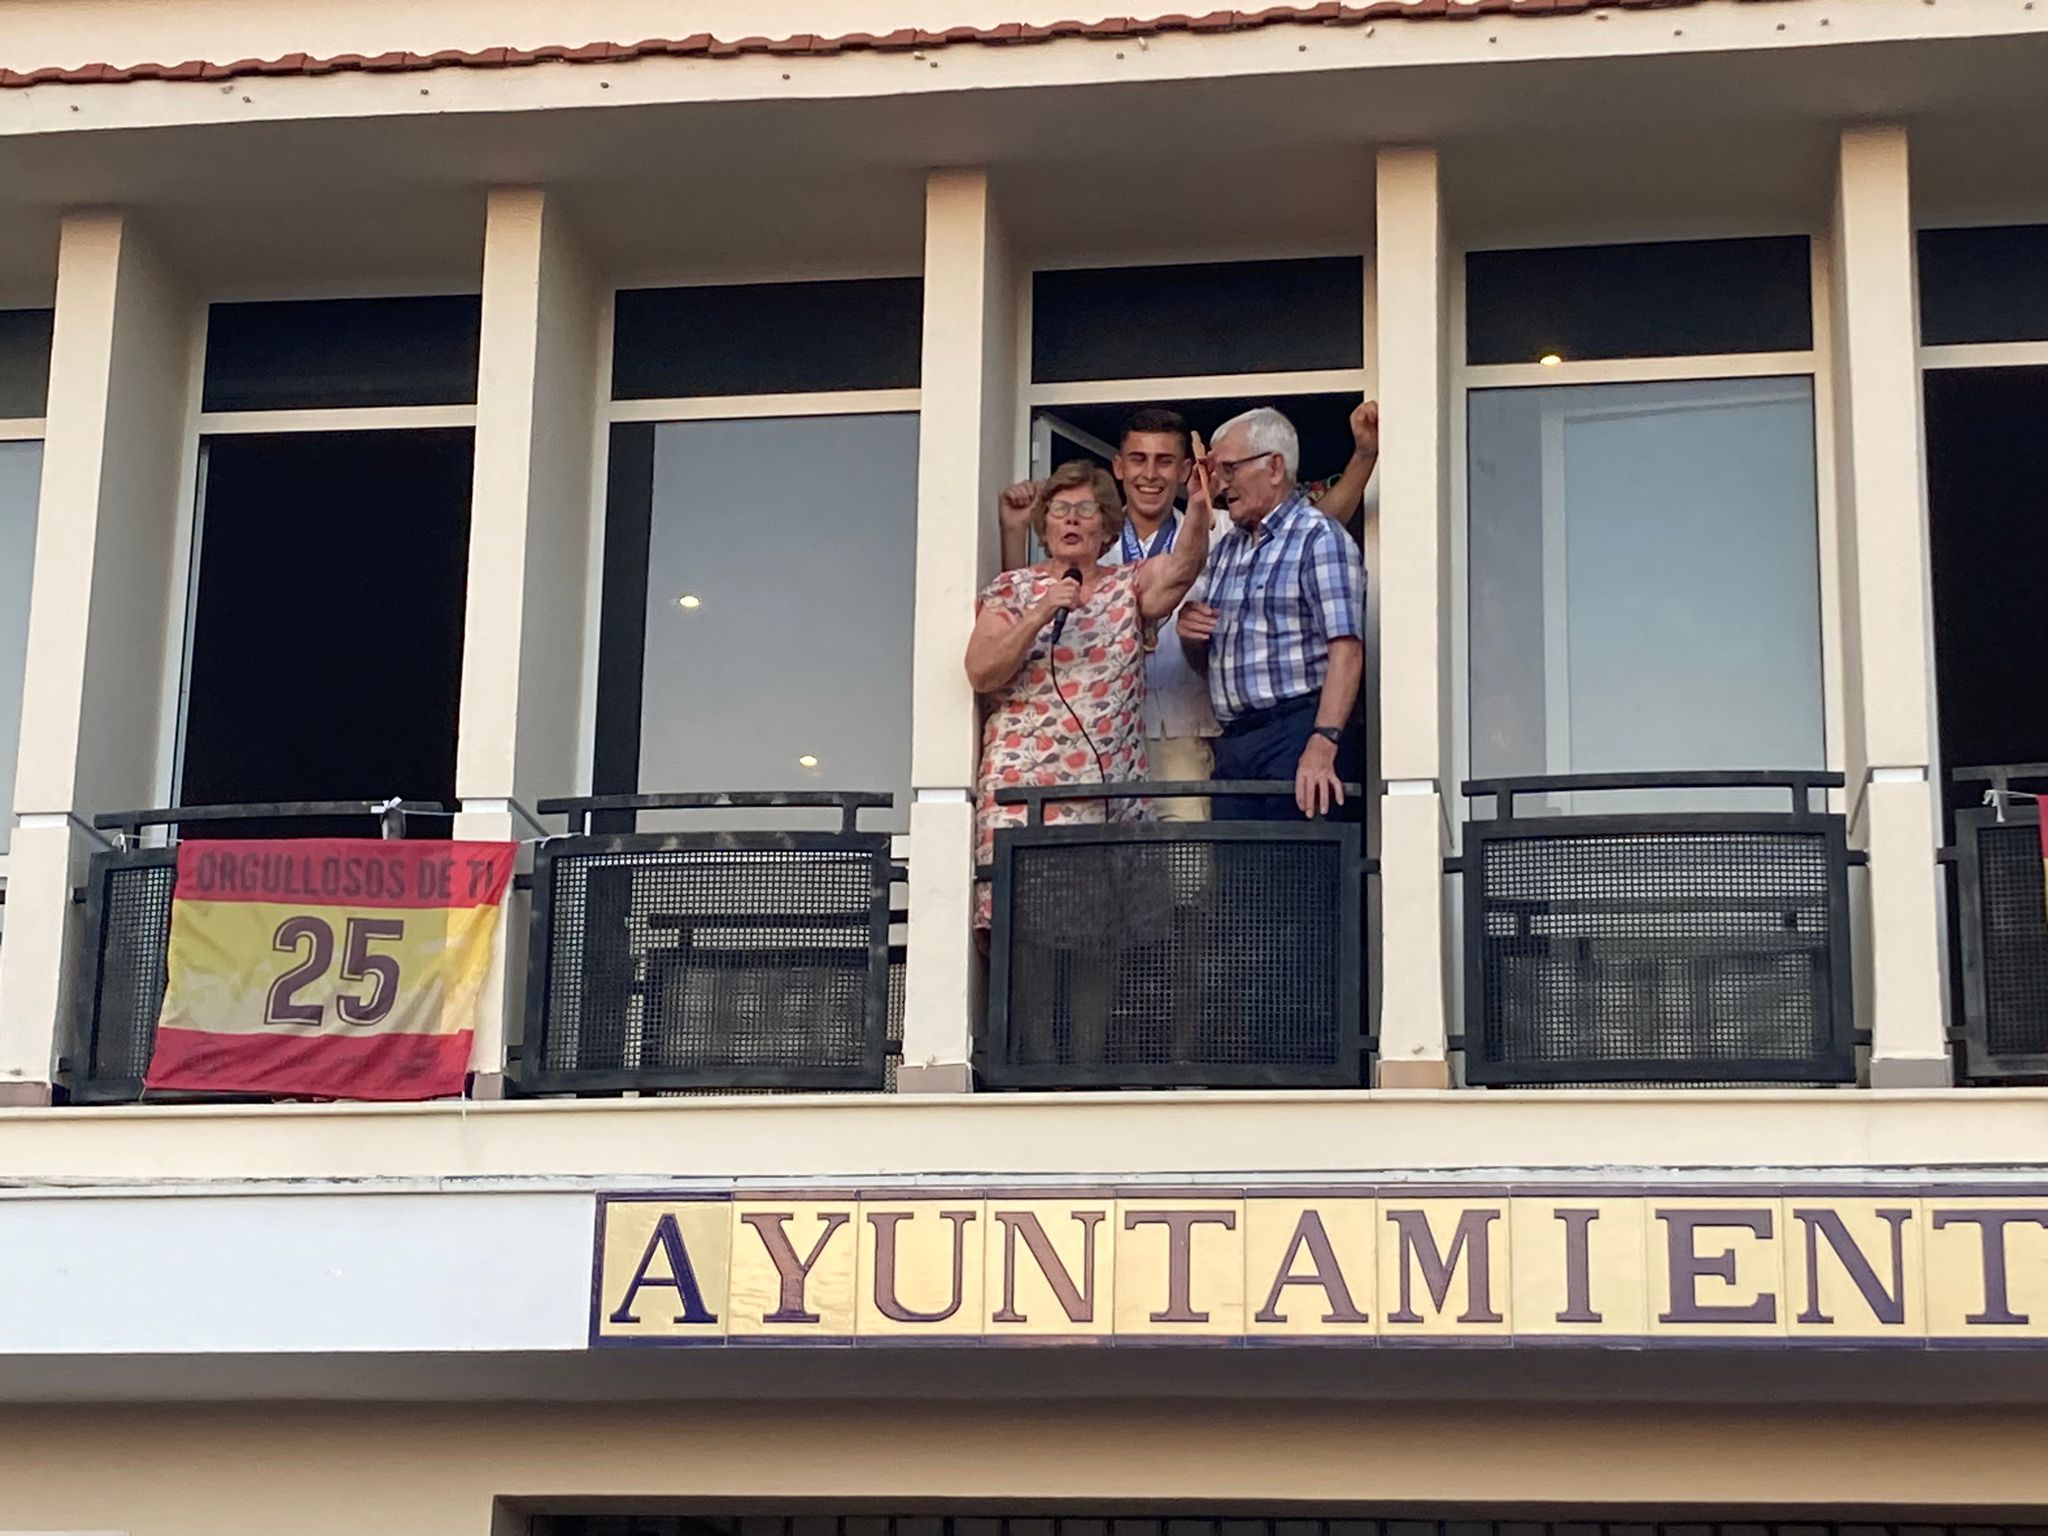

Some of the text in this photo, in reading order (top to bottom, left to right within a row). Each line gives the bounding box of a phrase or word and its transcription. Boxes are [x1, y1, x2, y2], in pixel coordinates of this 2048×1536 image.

[196, 851, 405, 899] ORGULLOSOS
[416, 858, 456, 900] DE
[263, 916, 405, 1027] 25
[609, 1208, 2048, 1324] AYUNTAMIENT
